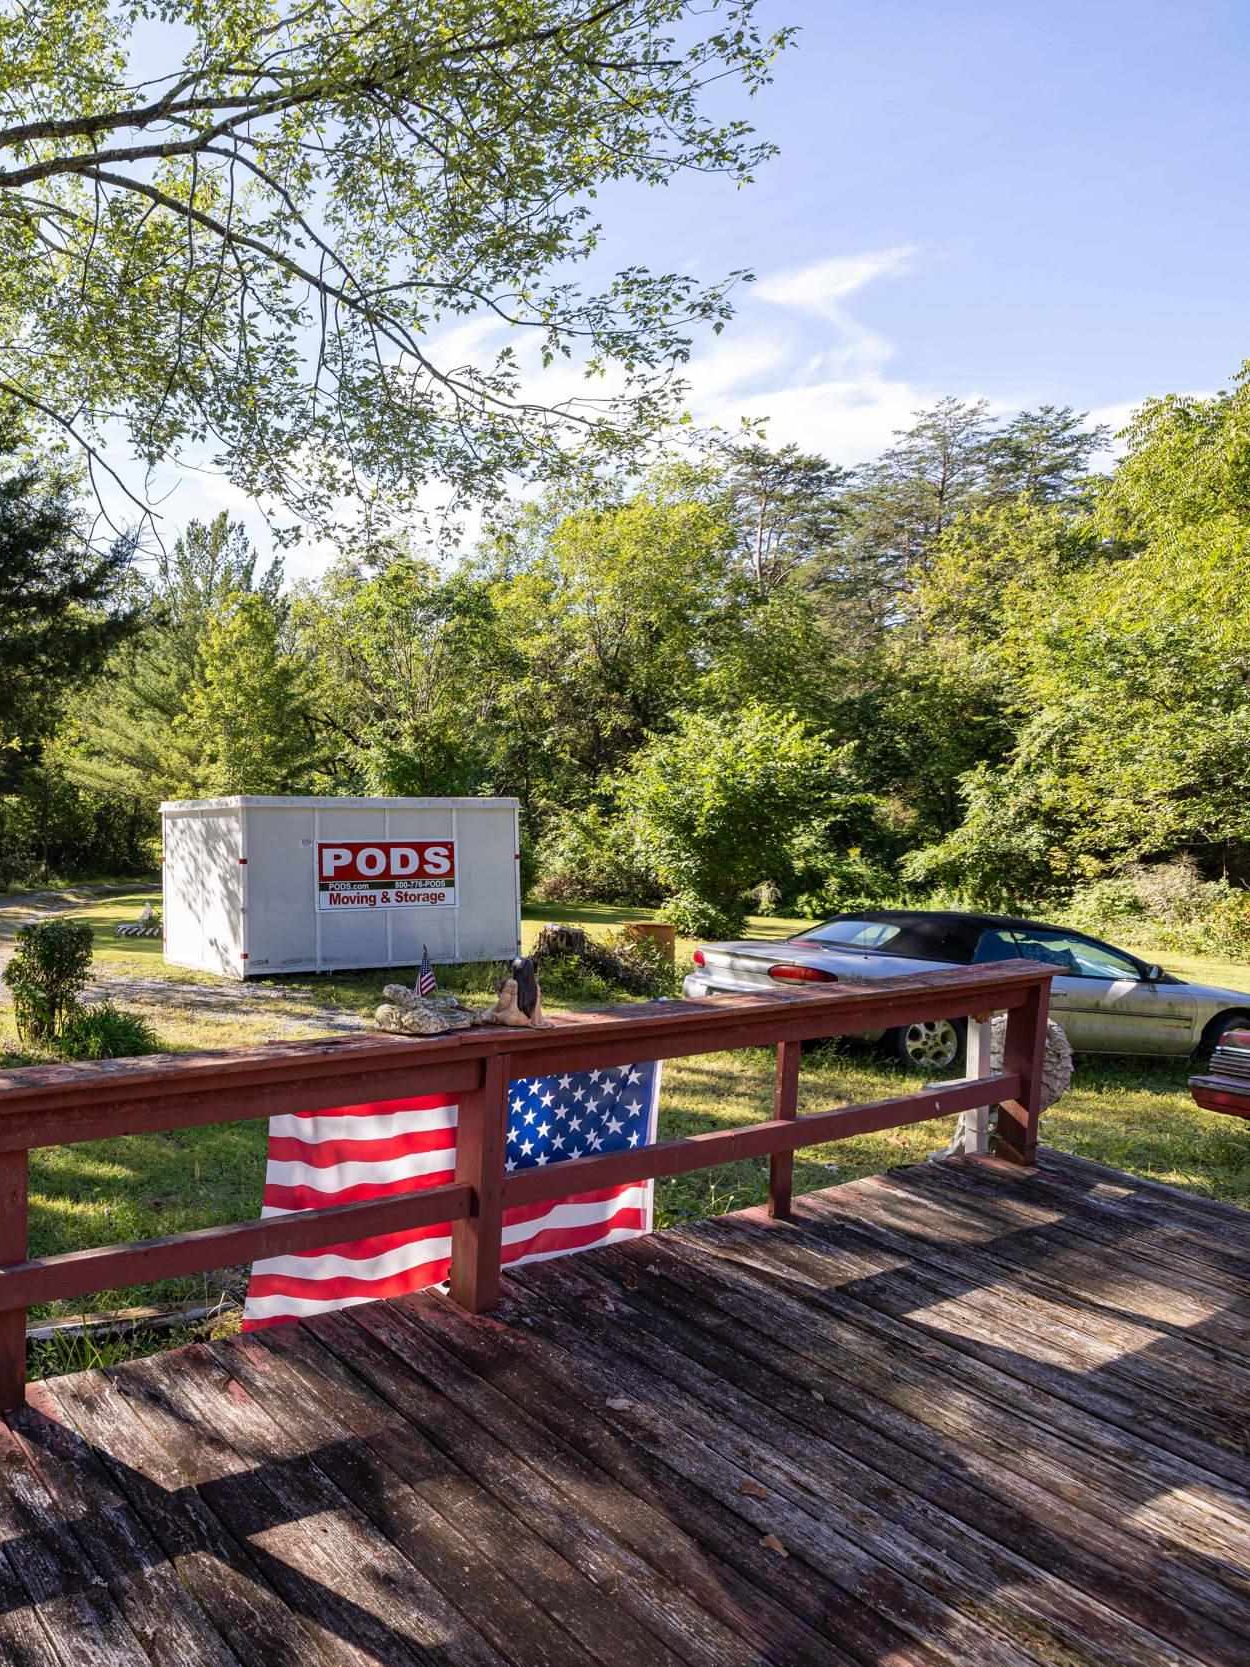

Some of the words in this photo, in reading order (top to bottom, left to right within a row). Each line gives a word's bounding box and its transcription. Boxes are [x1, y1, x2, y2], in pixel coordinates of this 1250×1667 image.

[322, 847, 451, 876] PODS
[329, 882, 369, 890] PODS.com
[329, 892, 377, 906] Moving
[381, 891, 390, 903] &
[395, 890, 446, 904] Storage
